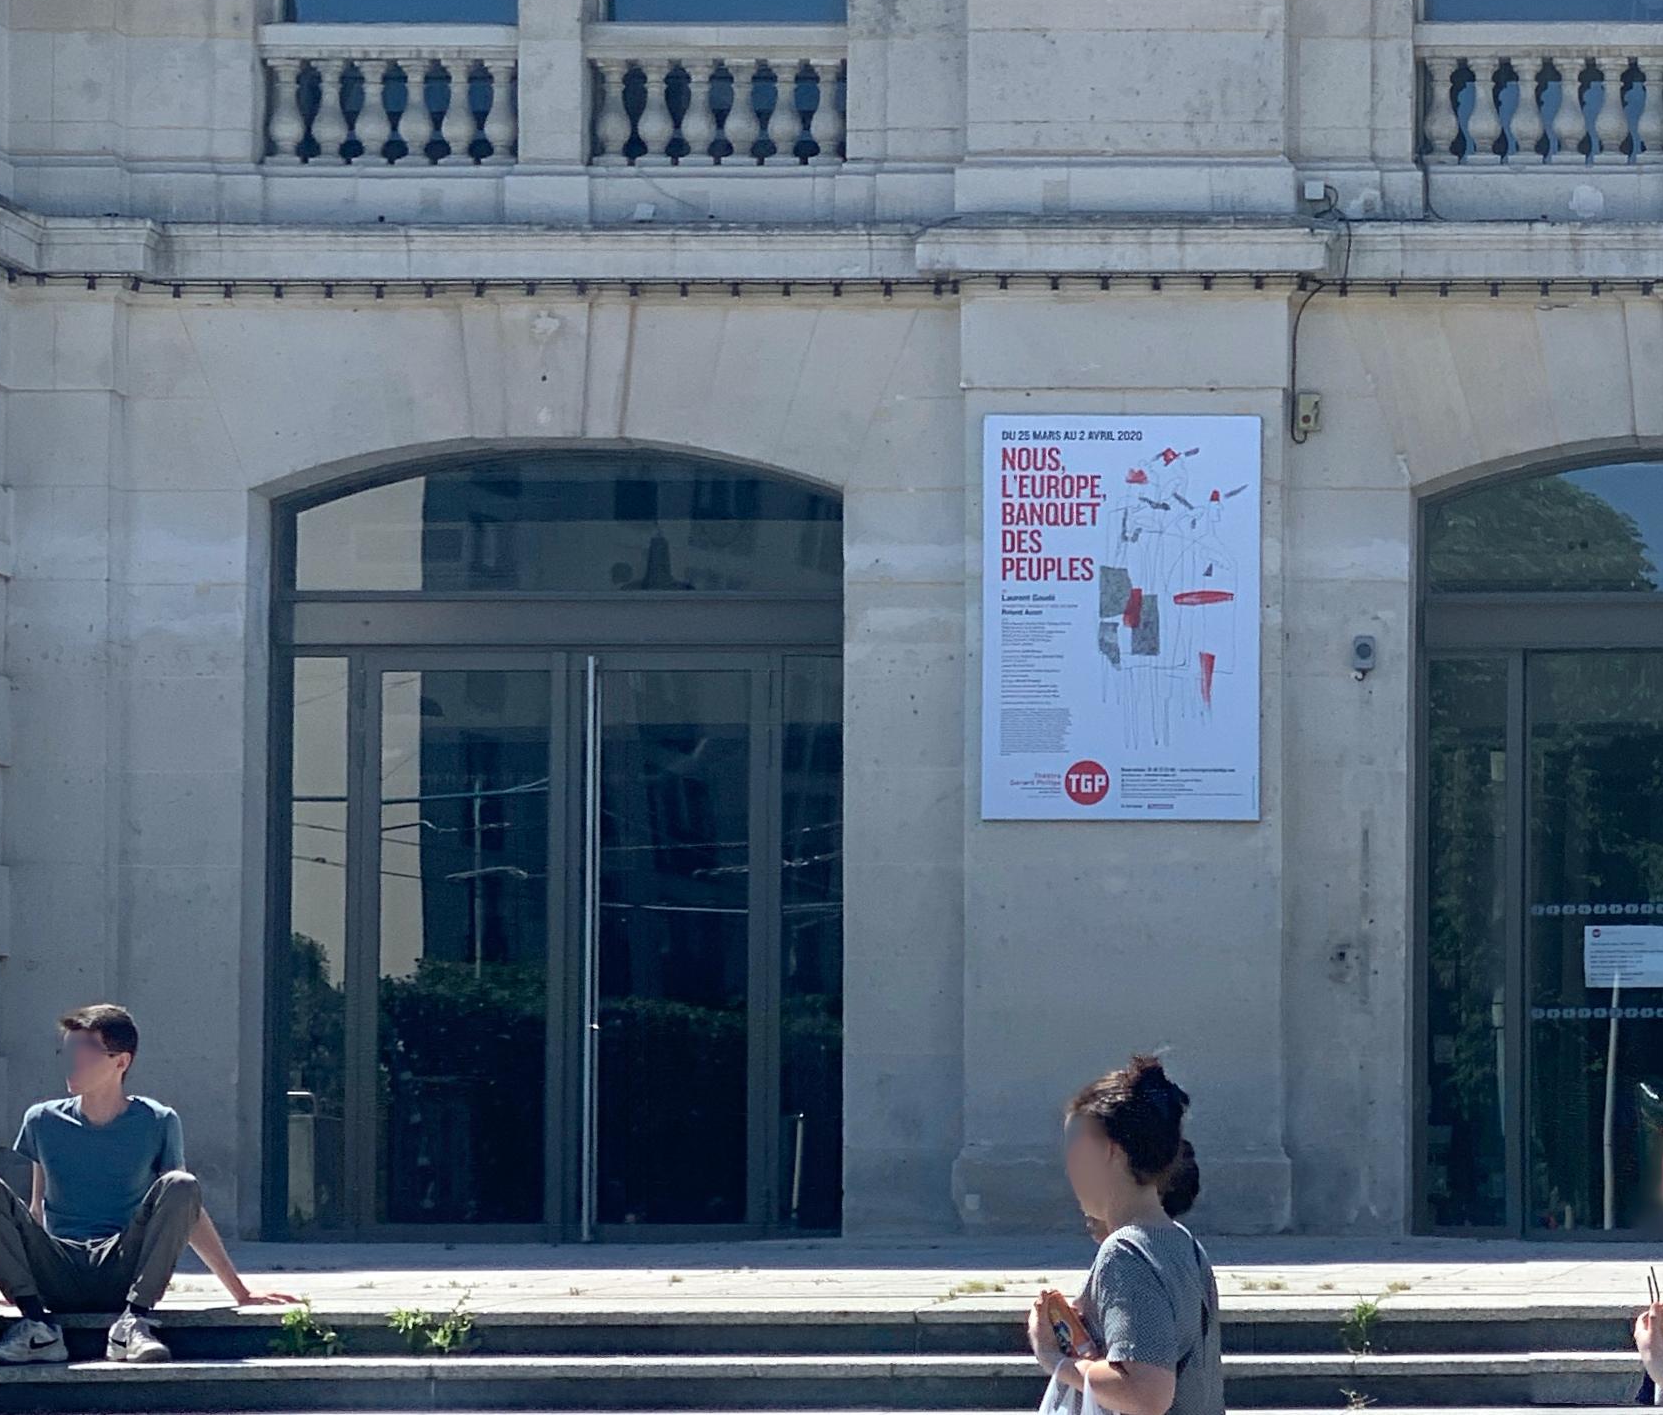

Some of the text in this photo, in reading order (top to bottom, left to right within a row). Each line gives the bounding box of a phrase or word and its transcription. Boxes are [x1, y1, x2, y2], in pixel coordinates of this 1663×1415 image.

[1002, 431, 1143, 441] DU 25 MARS AU 2 AVRIL 2020
[1001, 447, 1066, 474] NOUS,
[1001, 475, 1107, 501] L'EUROPE,
[1001, 503, 1101, 526] BANQUET
[1001, 530, 1042, 553] DES
[1001, 557, 1094, 581] PEUPLES
[1068, 773, 1106, 793] TGP
